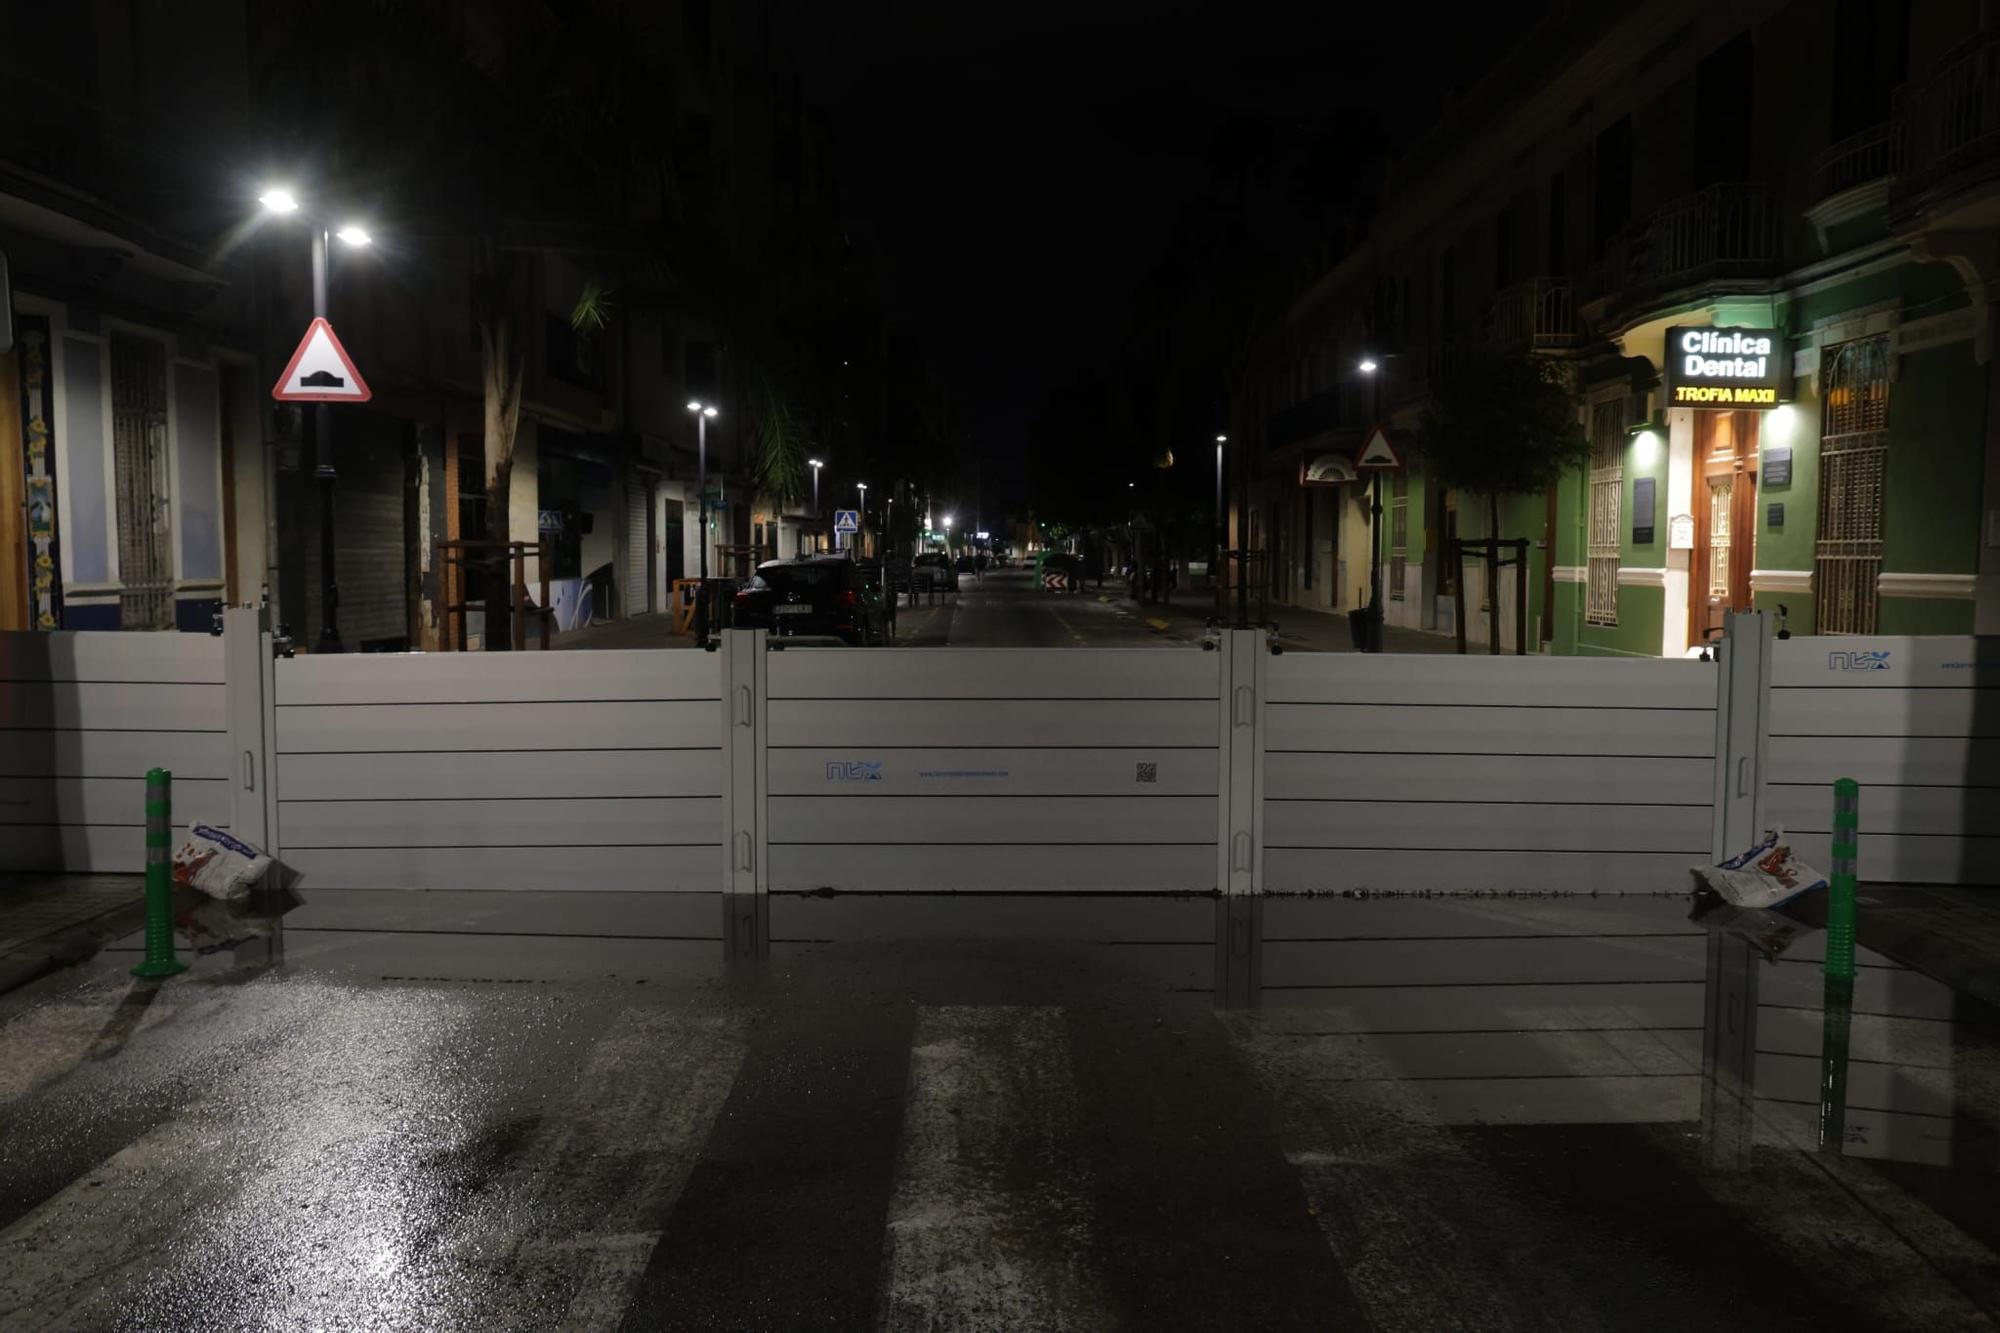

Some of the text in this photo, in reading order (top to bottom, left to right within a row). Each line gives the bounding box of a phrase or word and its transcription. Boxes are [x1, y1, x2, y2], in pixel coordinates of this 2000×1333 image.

[1682, 331, 1771, 355] Clínica
[1684, 355, 1766, 378] Dental
[1675, 386, 1733, 402] TROFIA
